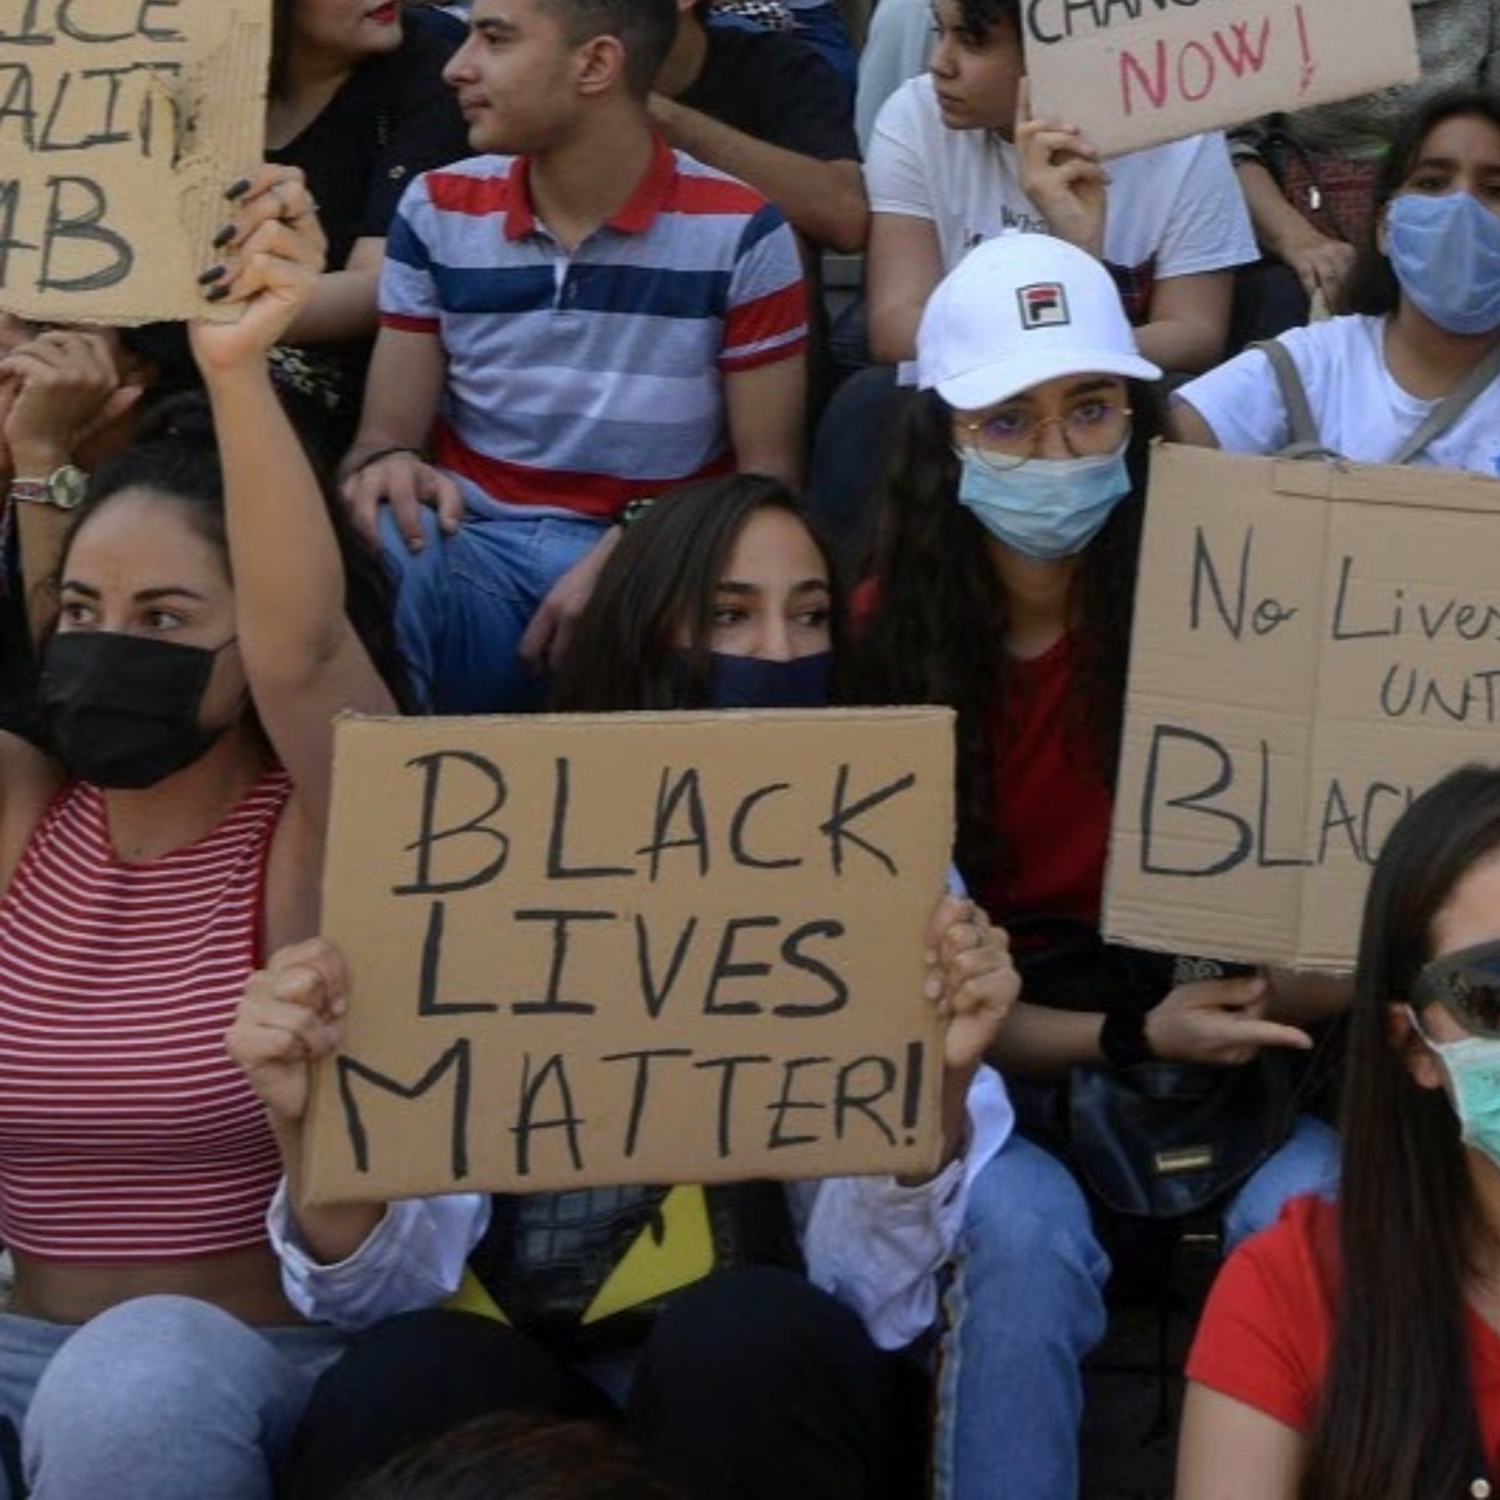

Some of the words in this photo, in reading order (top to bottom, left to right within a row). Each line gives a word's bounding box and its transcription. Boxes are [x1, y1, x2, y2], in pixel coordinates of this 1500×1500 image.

[1189, 524, 1298, 640] No
[391, 749, 916, 897] BLACK
[1139, 723, 1418, 878] BLAC
[417, 900, 850, 1019] LIVES
[335, 1037, 924, 1181] MATTER!
